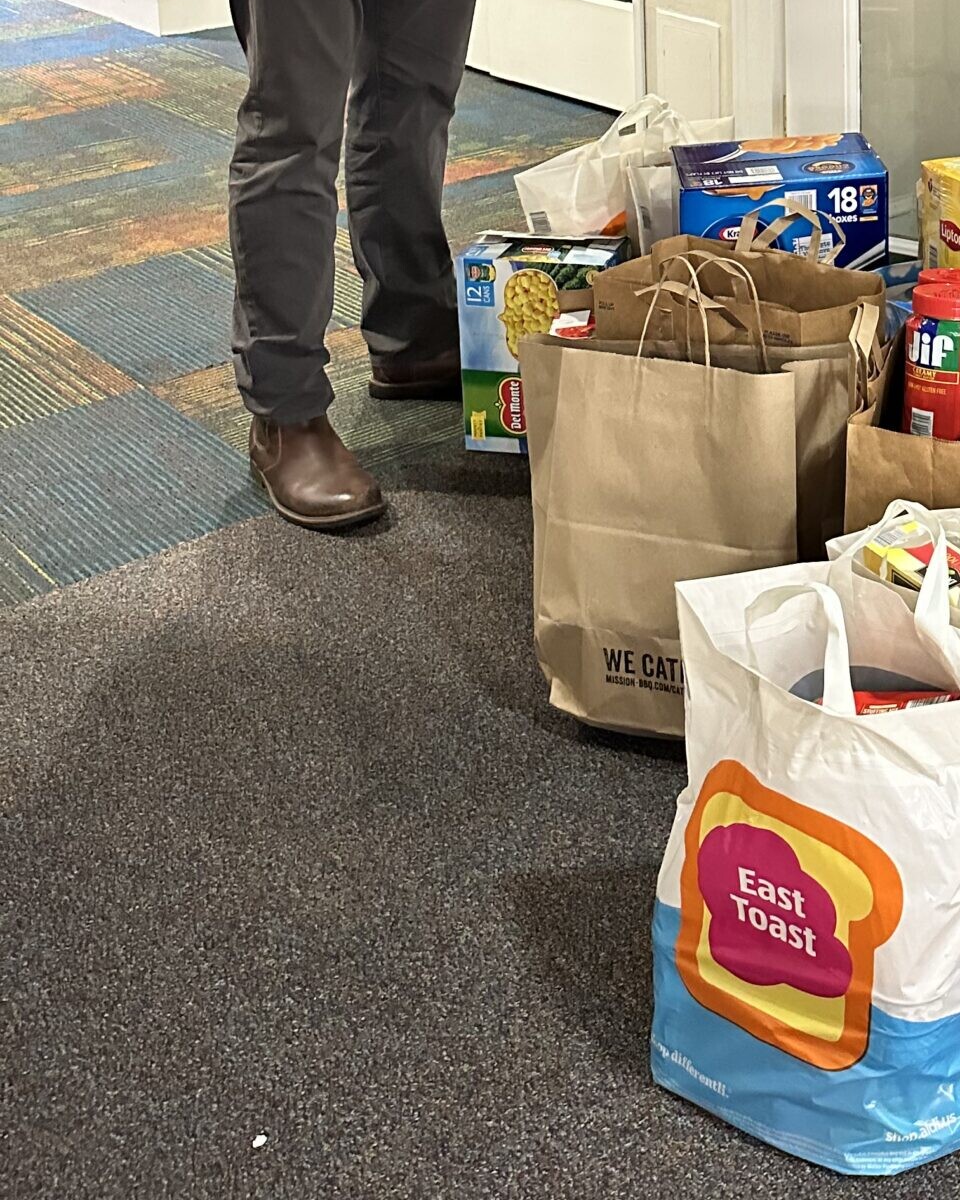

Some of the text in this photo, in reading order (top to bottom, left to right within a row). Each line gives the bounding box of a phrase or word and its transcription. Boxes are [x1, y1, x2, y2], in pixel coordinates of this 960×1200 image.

[828, 186, 858, 214] 18
[829, 213, 858, 224] boxes
[467, 285, 482, 303] 12
[908, 330, 954, 368] Jif
[511, 380, 522, 430] Del Monte
[603, 647, 634, 674] WE
[737, 866, 806, 920] East
[729, 896, 819, 959] Toast
